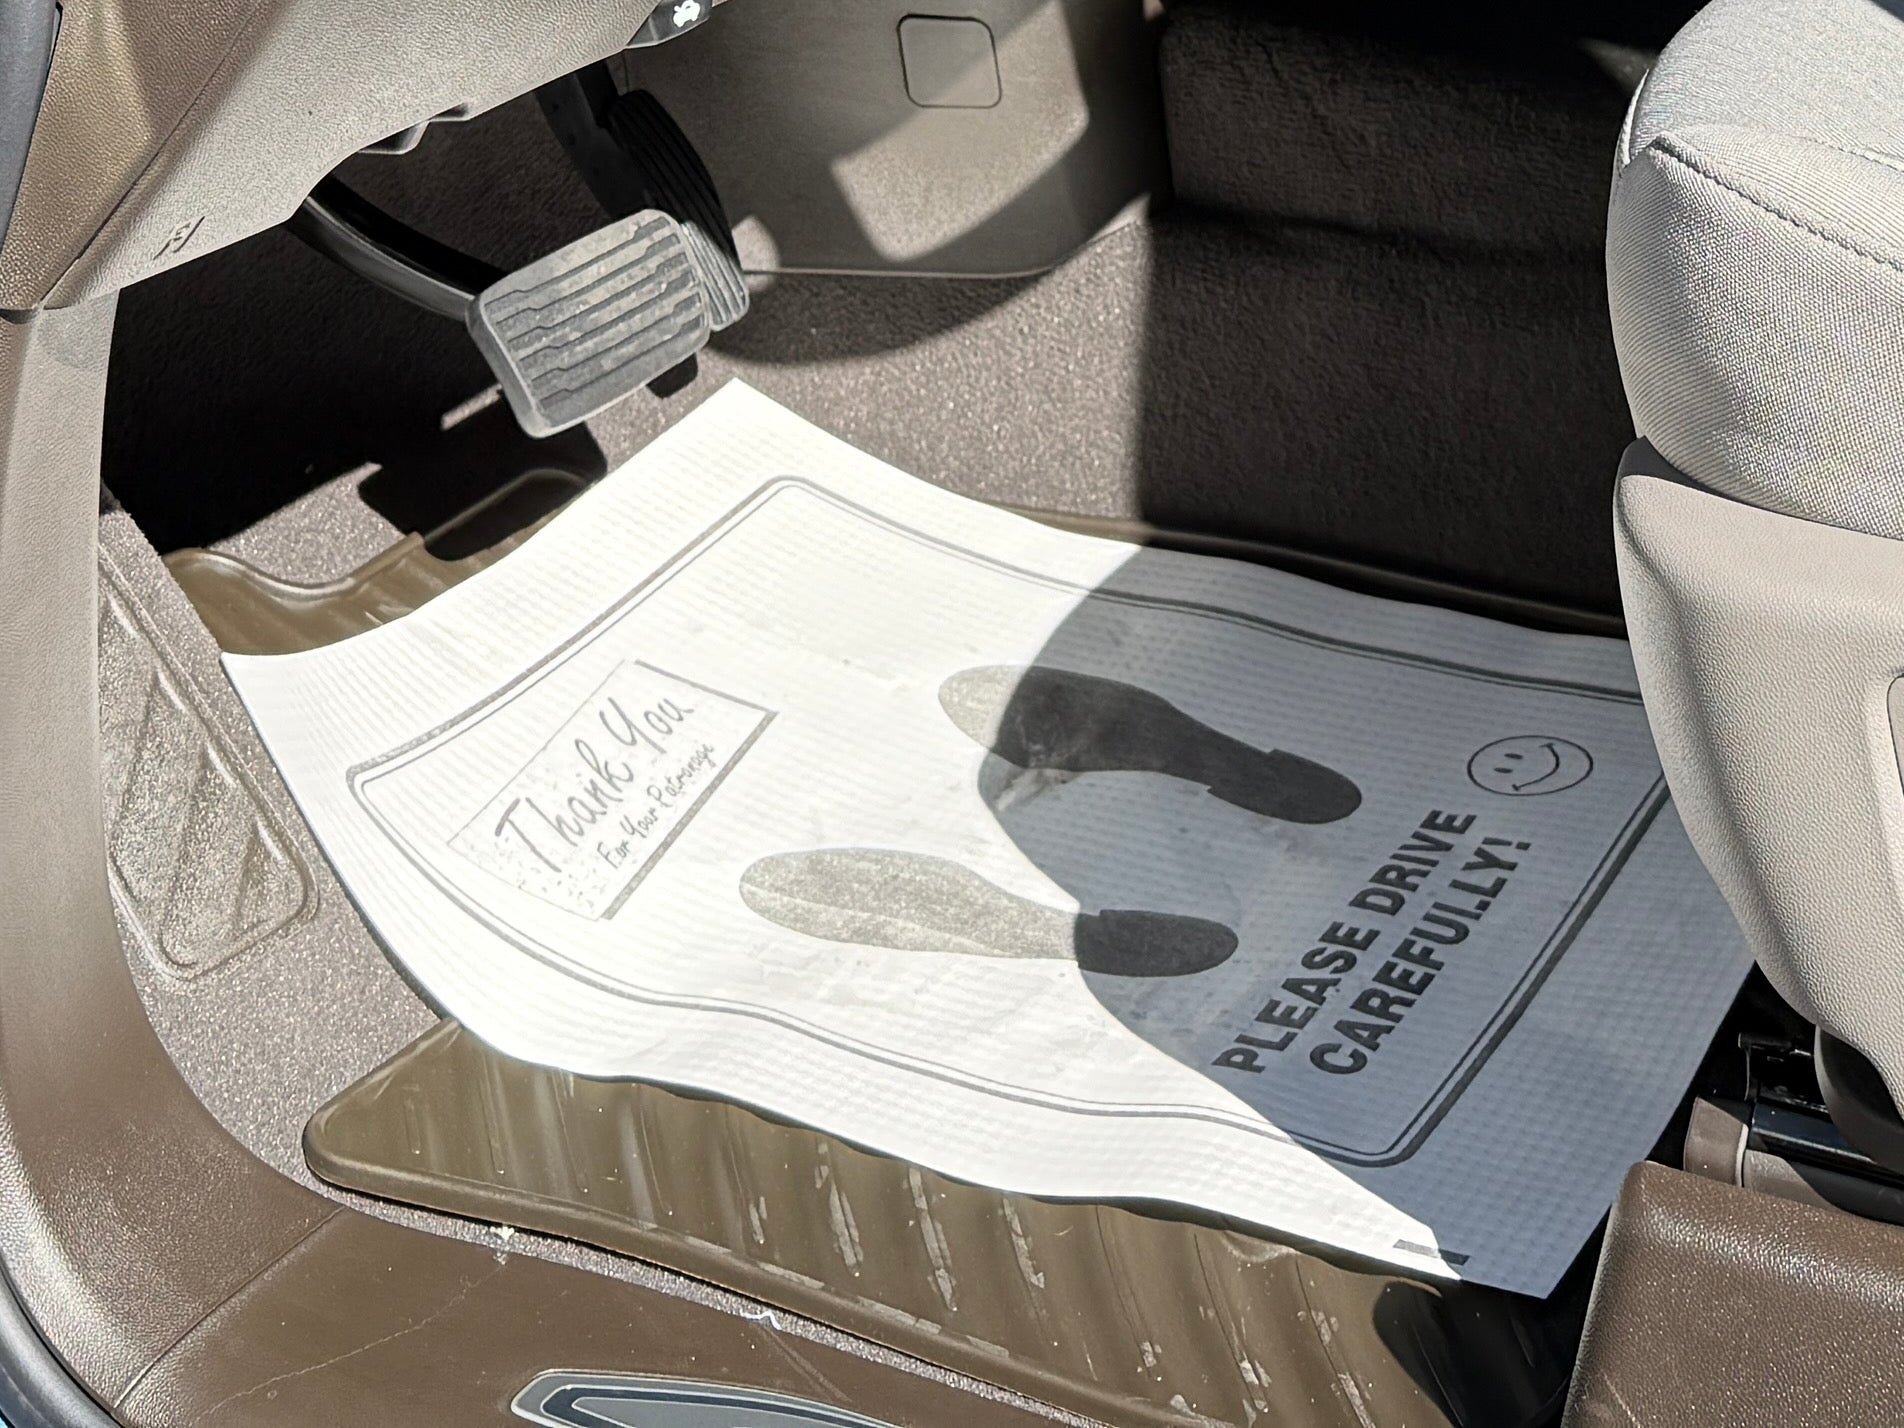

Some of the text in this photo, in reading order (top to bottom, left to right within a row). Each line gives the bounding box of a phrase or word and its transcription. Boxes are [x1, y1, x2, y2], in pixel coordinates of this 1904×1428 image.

[494, 696, 695, 873] Thank You
[597, 743, 715, 869] For Your Patronage
[1210, 809, 1478, 1074] PLEASE DRIVE
[1308, 837, 1533, 1076] CAREFULLY!
